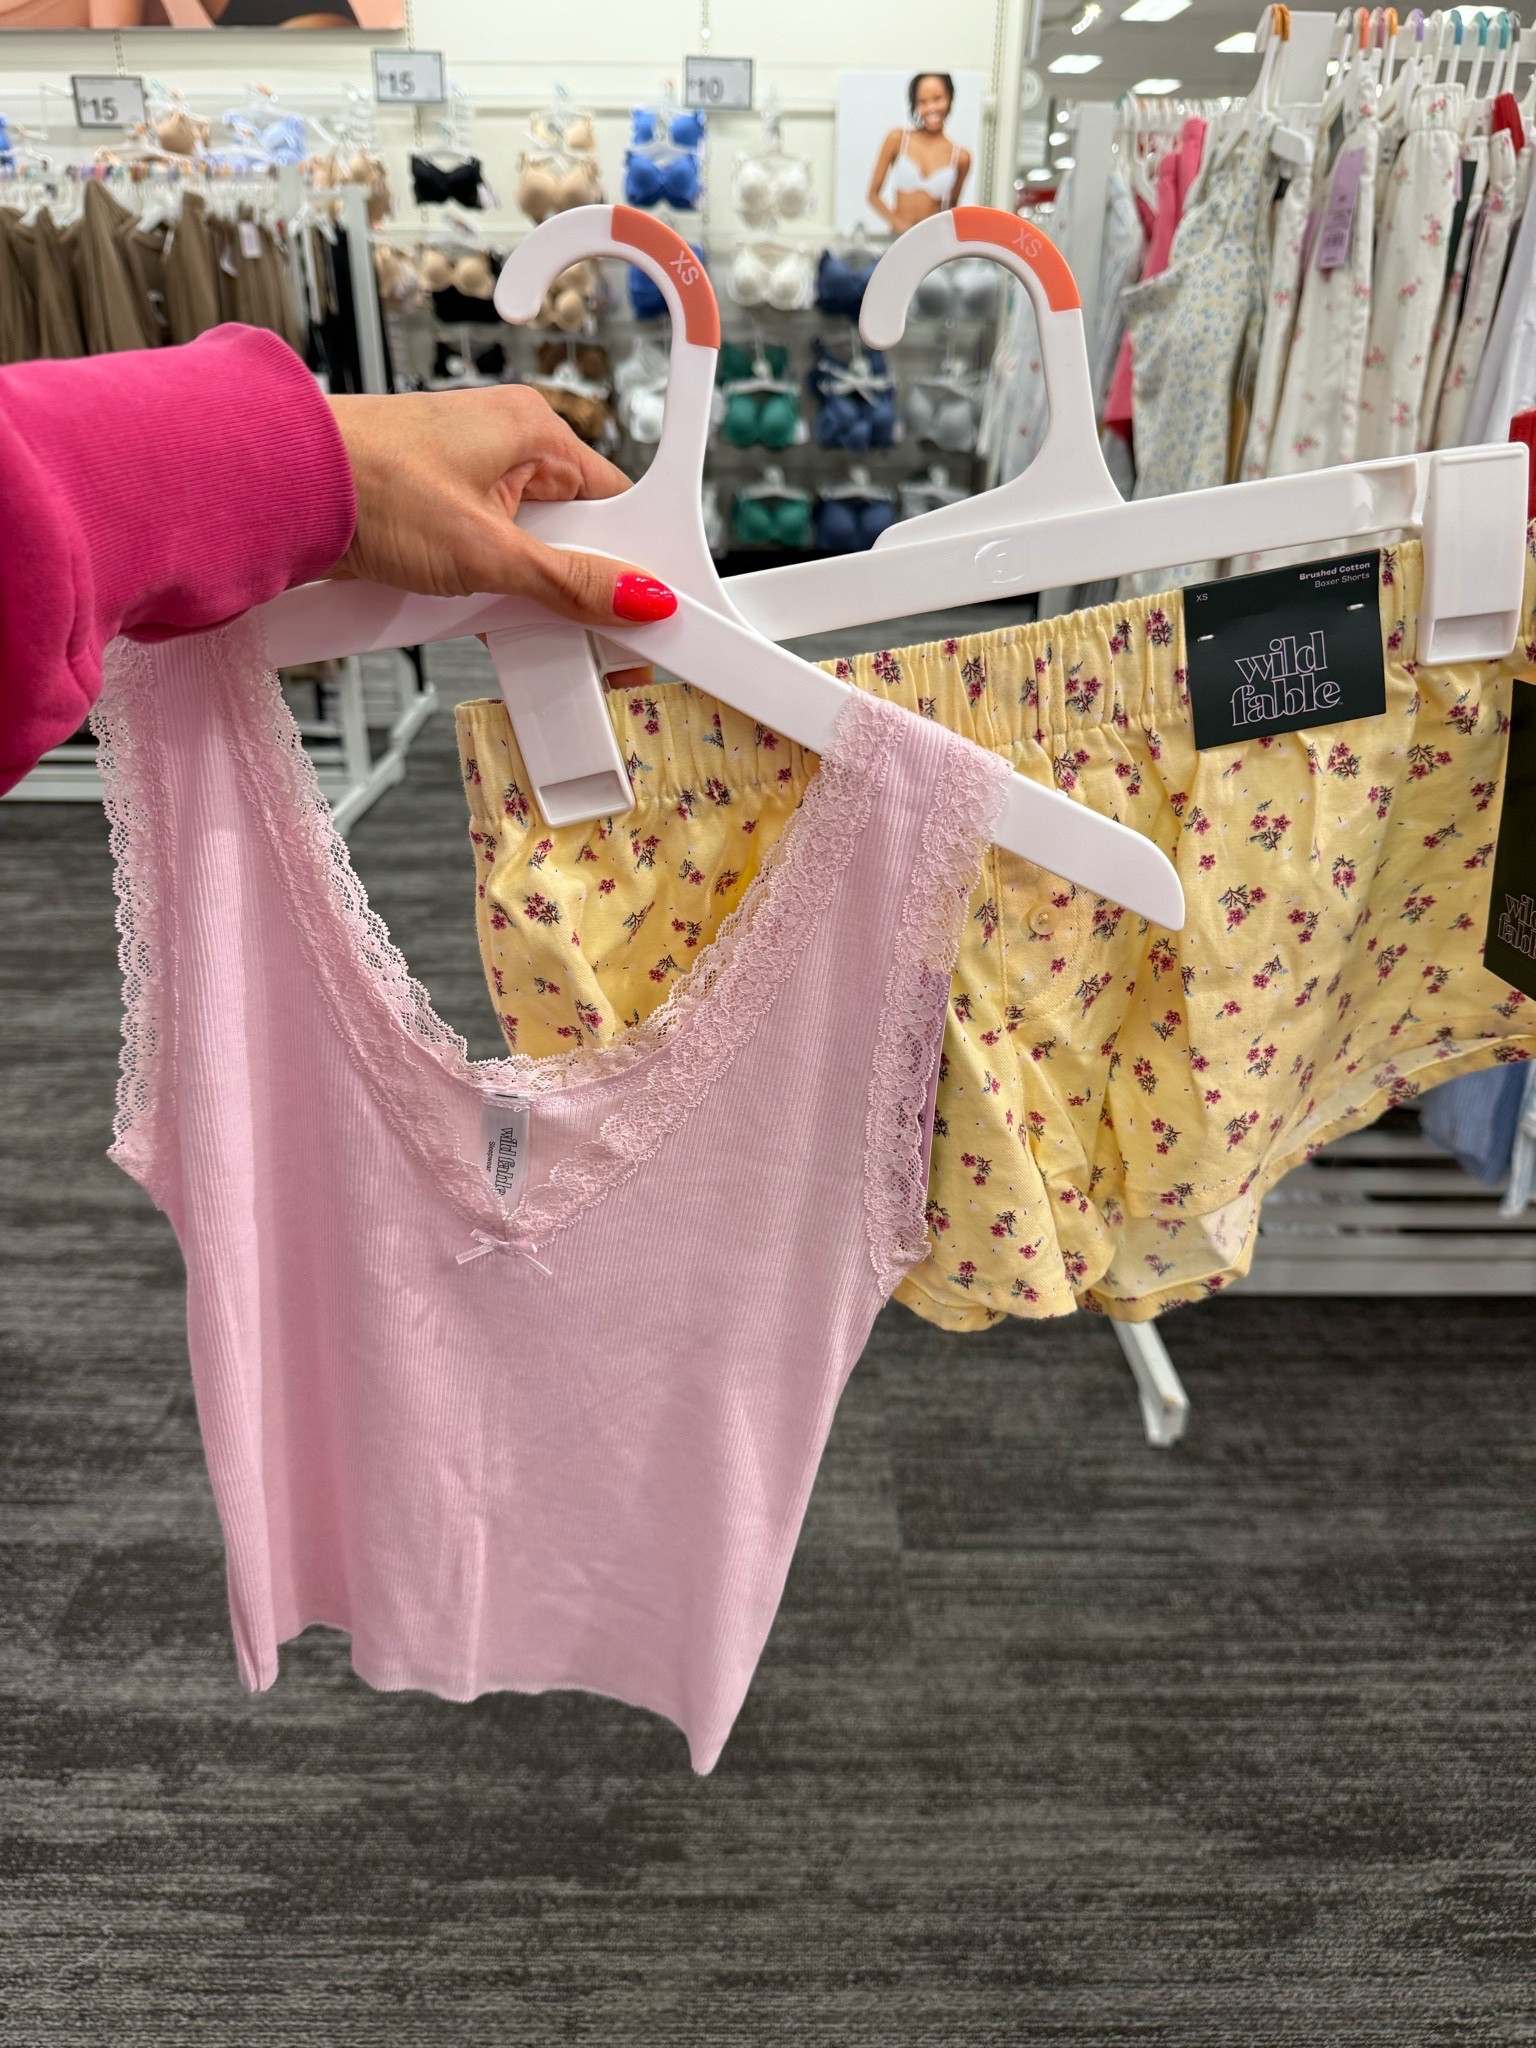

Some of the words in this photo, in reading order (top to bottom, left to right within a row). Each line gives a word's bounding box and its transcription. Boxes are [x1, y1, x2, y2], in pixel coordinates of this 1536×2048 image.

[1011, 227, 1043, 258] XS
[669, 250, 700, 286] XS
[1299, 567, 1337, 581] Brushed
[1339, 561, 1371, 574] Cotton
[1314, 578, 1340, 588] Boxer
[1341, 572, 1371, 583] Shorts
[1196, 593, 1209, 602] XS
[1234, 630, 1328, 684] wild
[1229, 673, 1341, 727] fable
[1497, 912, 1536, 960] fabl
[486, 1140, 496, 1173] Sleepwear
[499, 1127, 518, 1154] wild
[495, 1154, 516, 1196] fable
